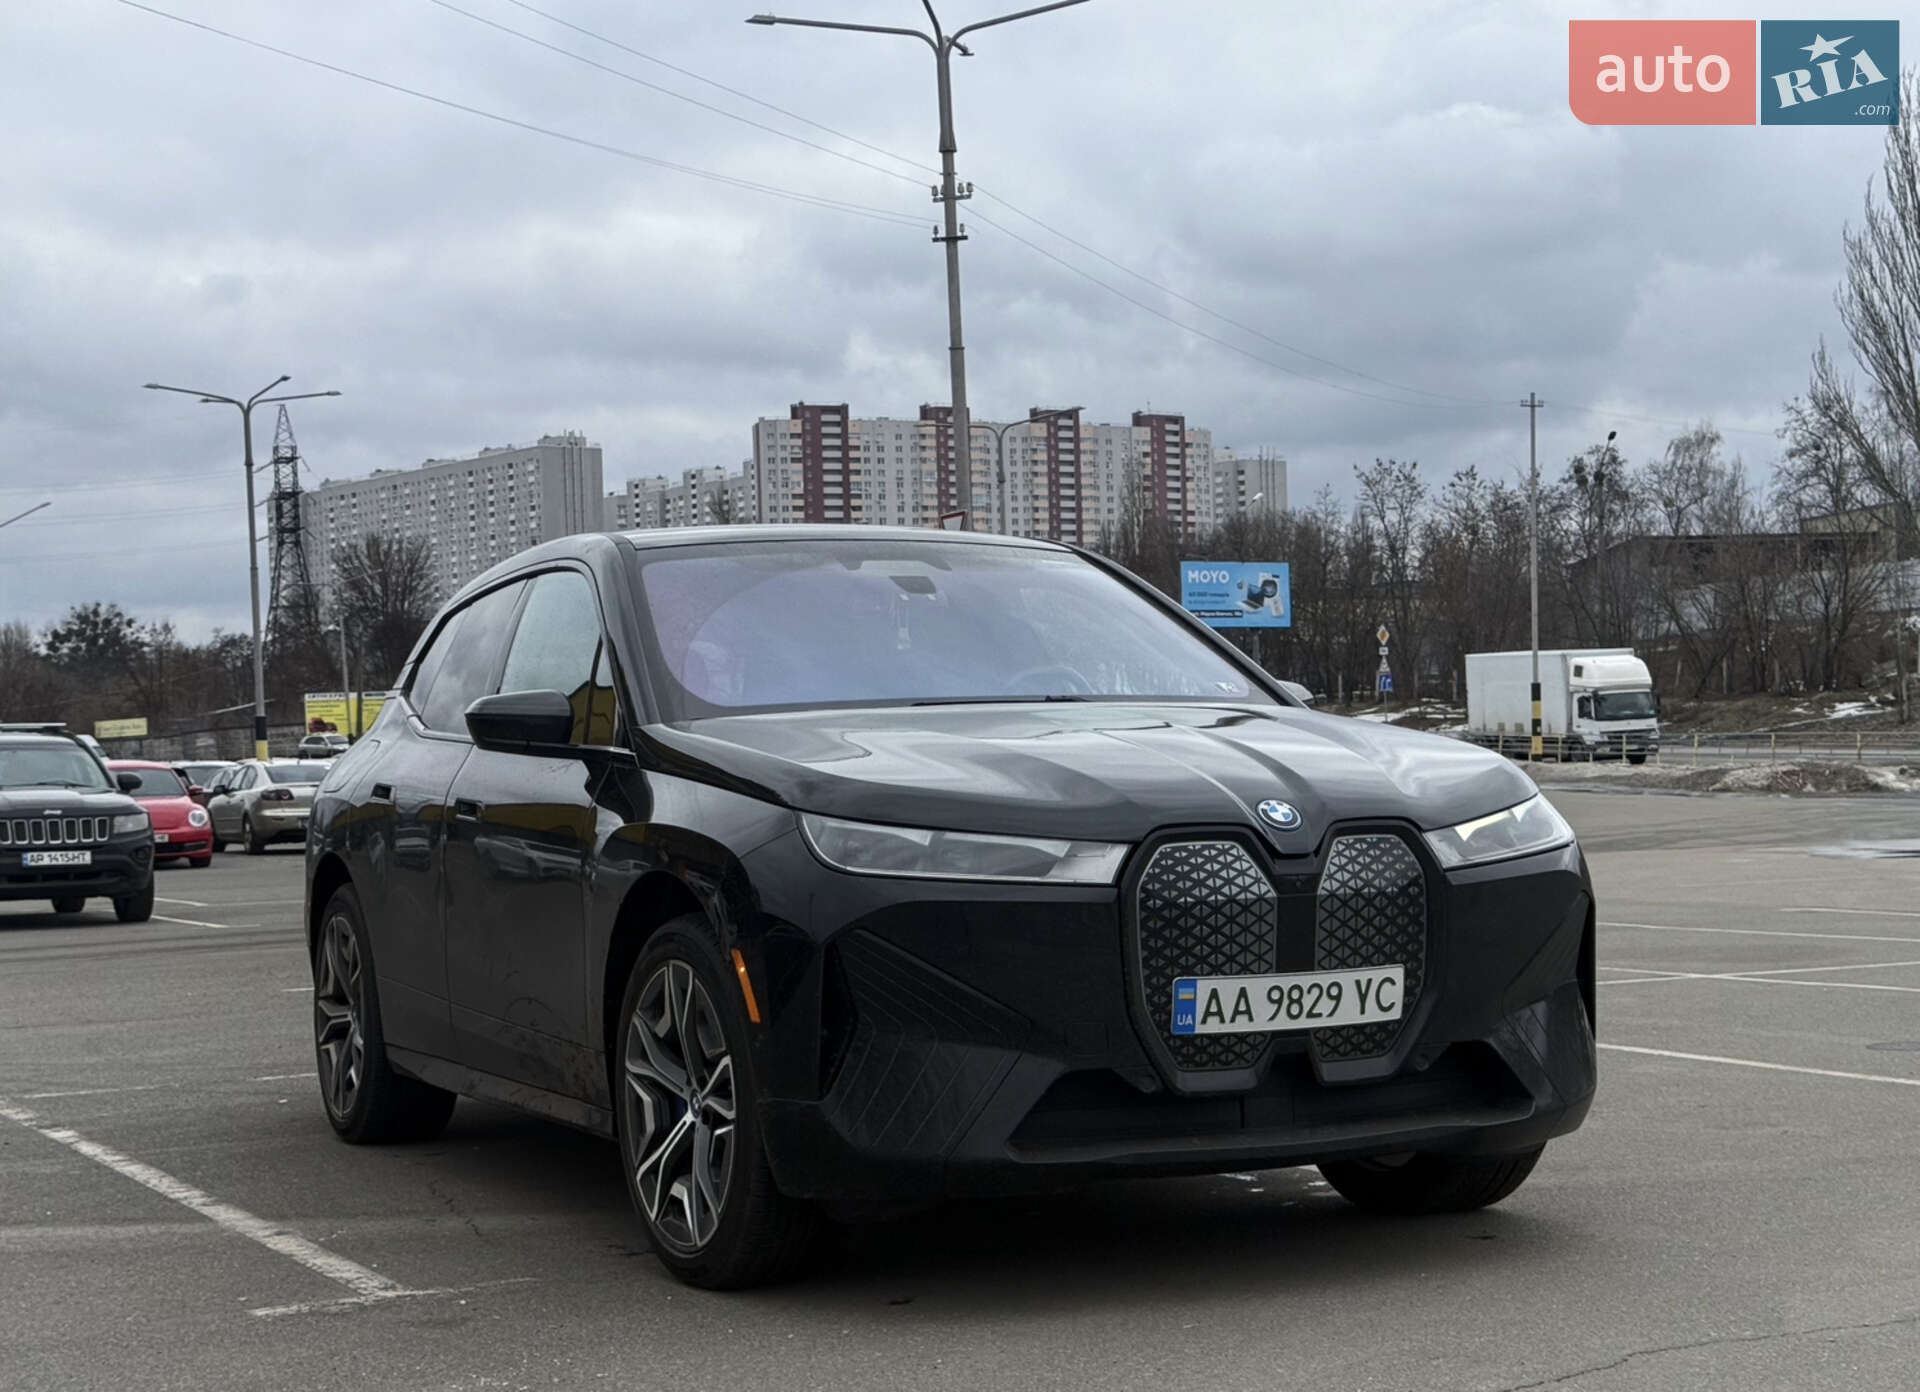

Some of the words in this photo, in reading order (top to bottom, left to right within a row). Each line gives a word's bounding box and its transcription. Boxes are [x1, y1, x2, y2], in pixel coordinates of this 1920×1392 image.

[1187, 570, 1230, 584] MOYO
[1200, 986, 1254, 1025] AA
[1266, 981, 1343, 1022] 9829
[1354, 976, 1397, 1015] YC
[1177, 1014, 1194, 1026] UA
